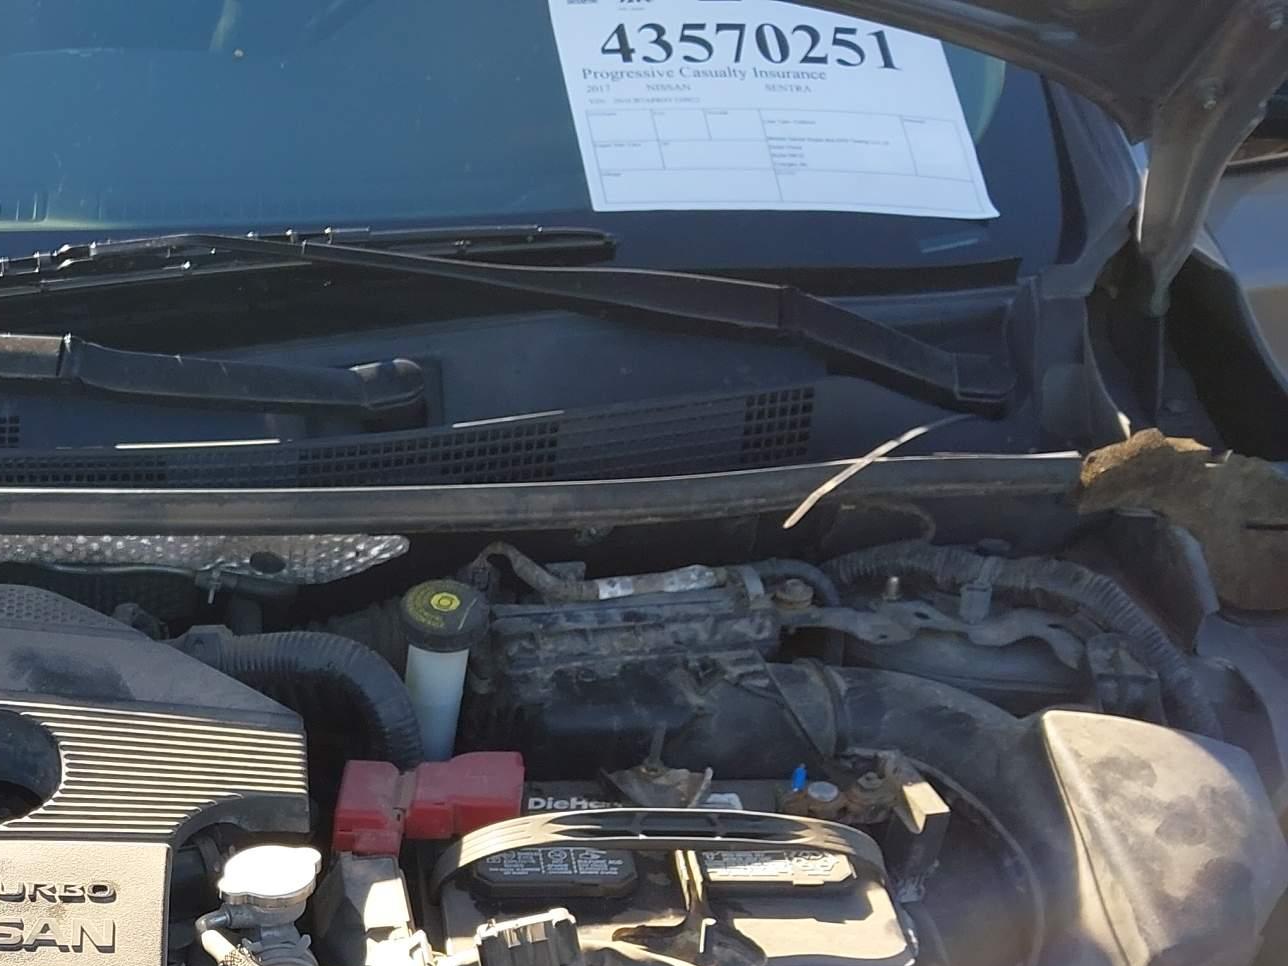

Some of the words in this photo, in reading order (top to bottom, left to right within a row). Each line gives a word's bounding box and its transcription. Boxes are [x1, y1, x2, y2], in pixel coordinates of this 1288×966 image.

[601, 22, 903, 71] 43570251
[582, 67, 675, 81] Progressive
[679, 67, 746, 81] Casualty
[753, 67, 827, 80] Insurance
[586, 84, 611, 93] 2017
[646, 83, 691, 91] NISSAN
[765, 83, 812, 93] SENTRA
